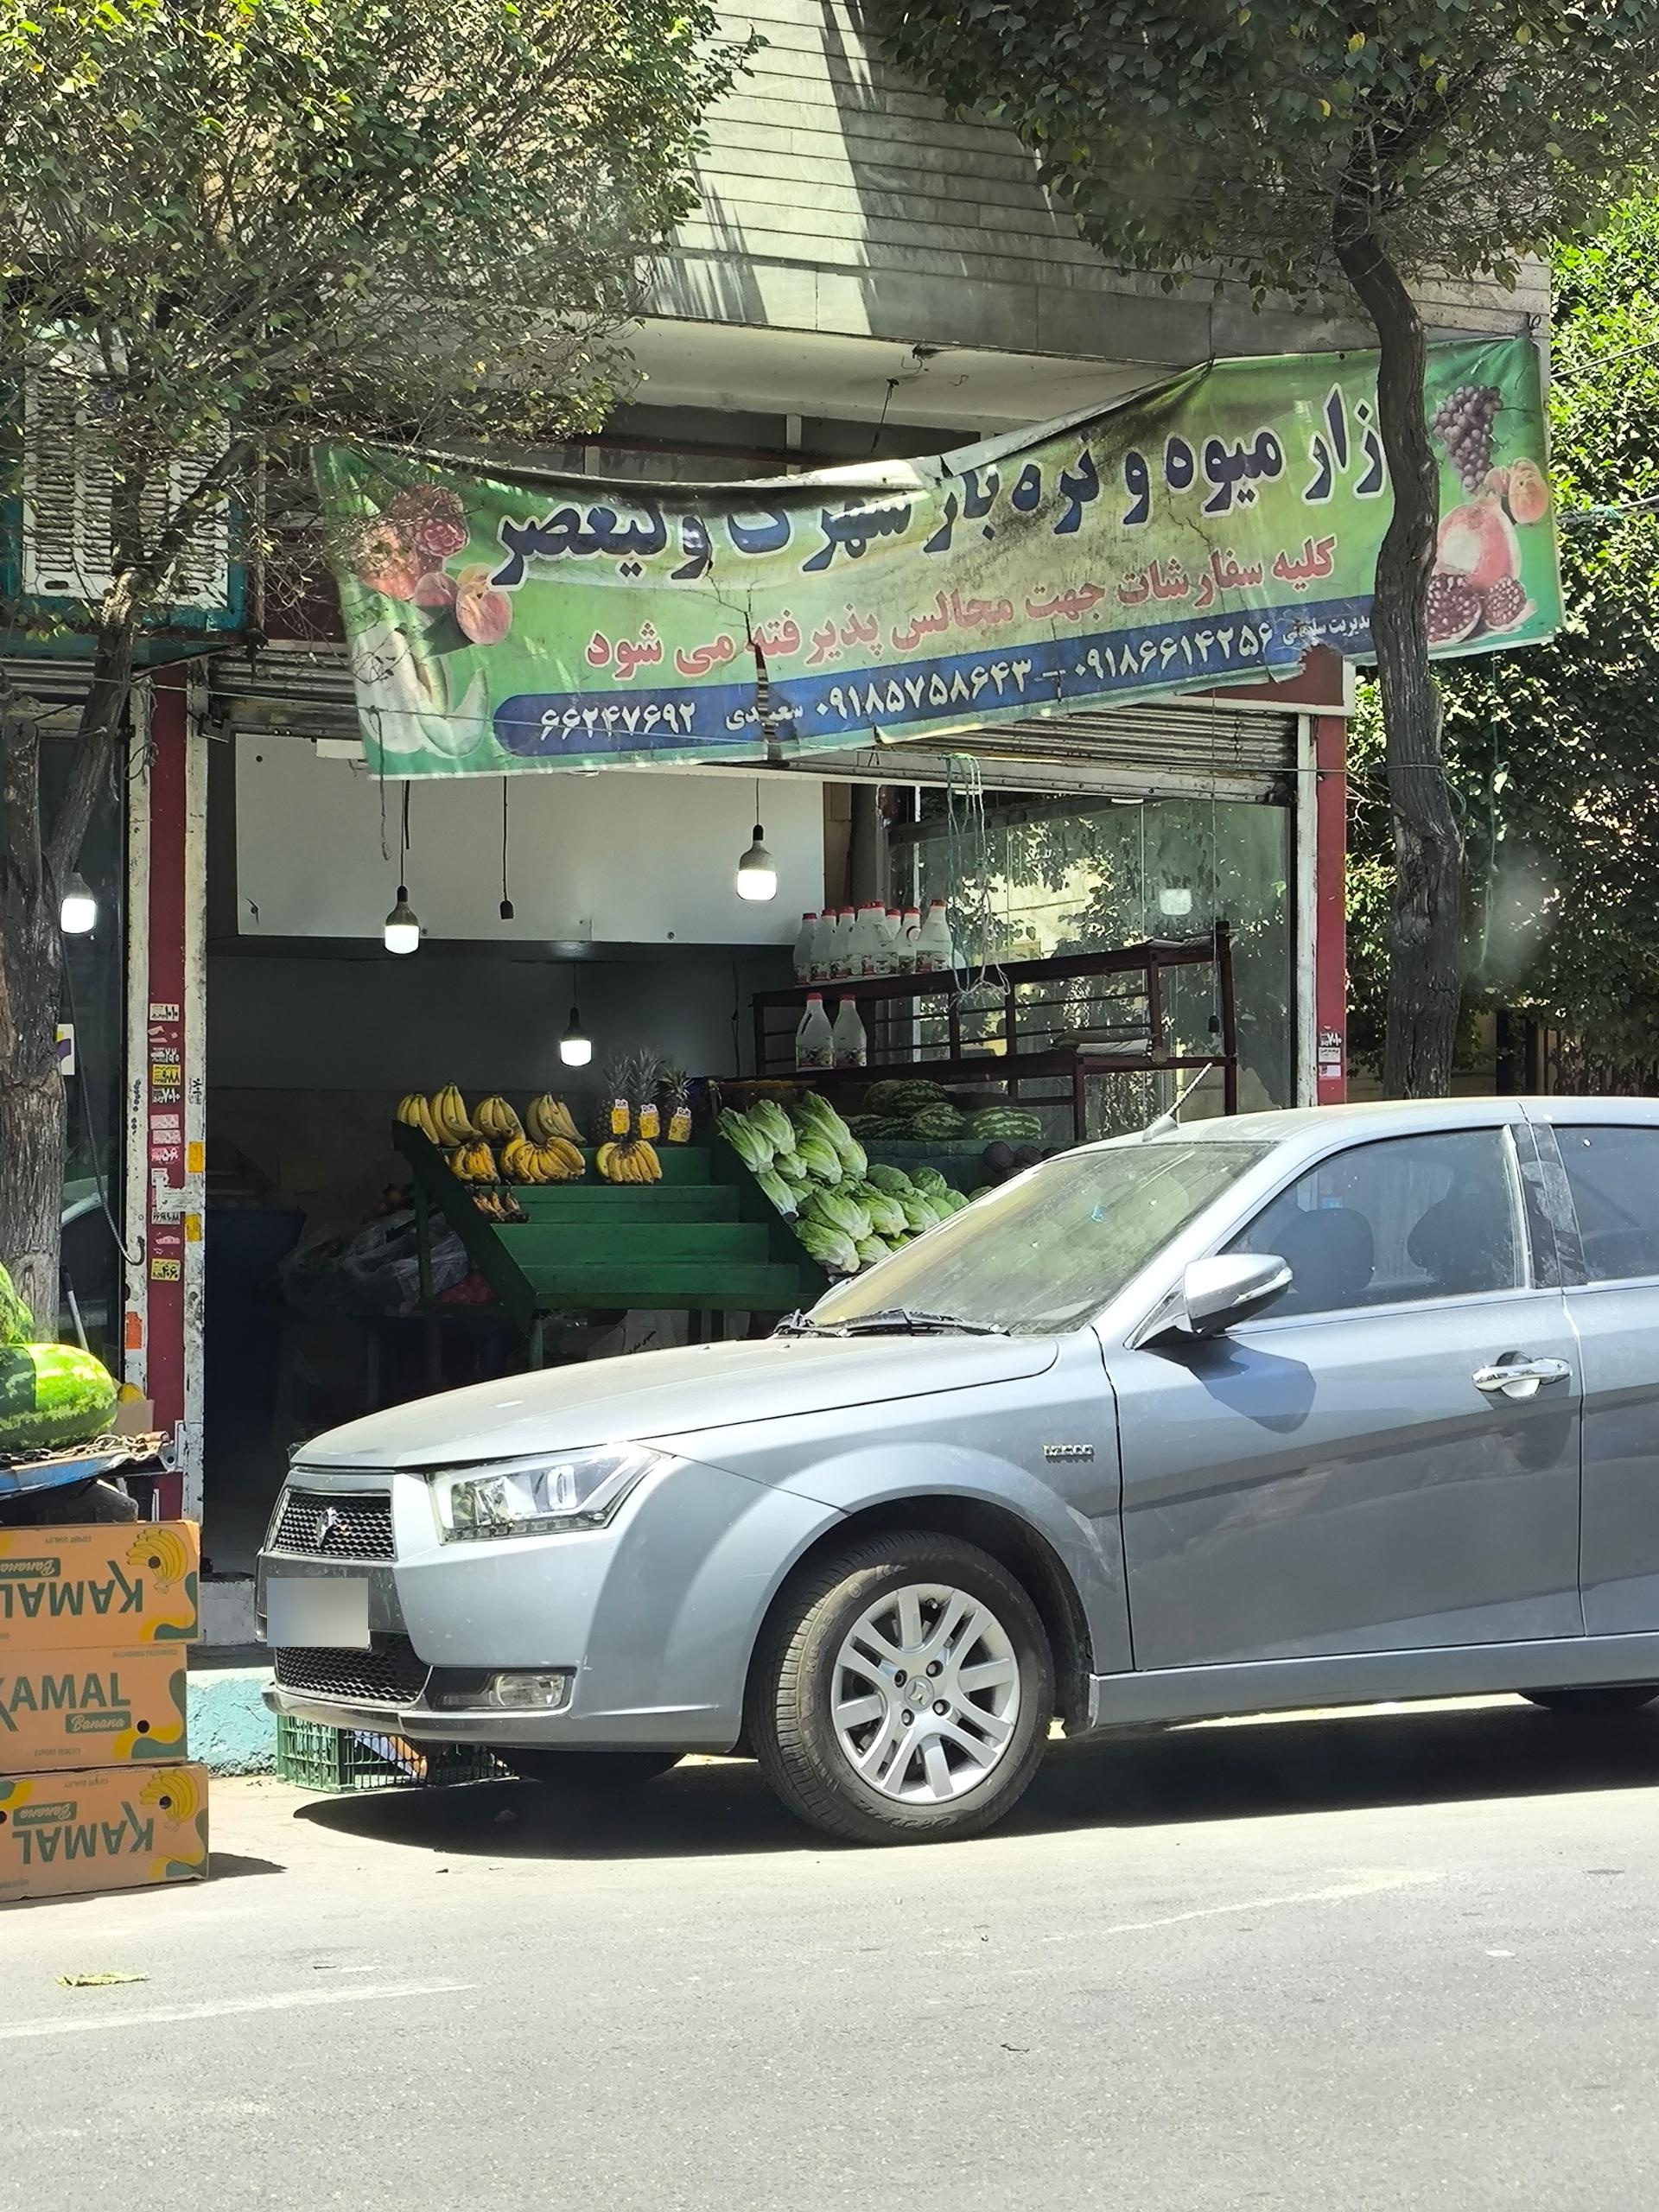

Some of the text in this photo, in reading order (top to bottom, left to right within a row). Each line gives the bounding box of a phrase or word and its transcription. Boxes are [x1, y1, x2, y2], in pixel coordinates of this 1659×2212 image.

[1122, 449, 1152, 526] و
[1164, 429, 1285, 516] میوه
[922, 467, 1001, 555] بار
[585, 534, 1337, 682] کلیه سفارشات جهت مجالس پذیرفته می شود
[1074, 621, 1274, 680] ۰۹۱۸۶۶۱۴۲۵۶
[816, 658, 1033, 721] ۰۹۱۸۵۷۵۸۶۴۳
[539, 702, 696, 741] ۶۶۲۴۷۶۹۲
[0, 1558, 55, 1577] Banana
[0, 1560, 143, 1618] KAMAL
[71, 1713, 126, 1732] Banana
[11, 1800, 155, 1865] KAMAL
[19, 1802, 72, 1821] Banana
